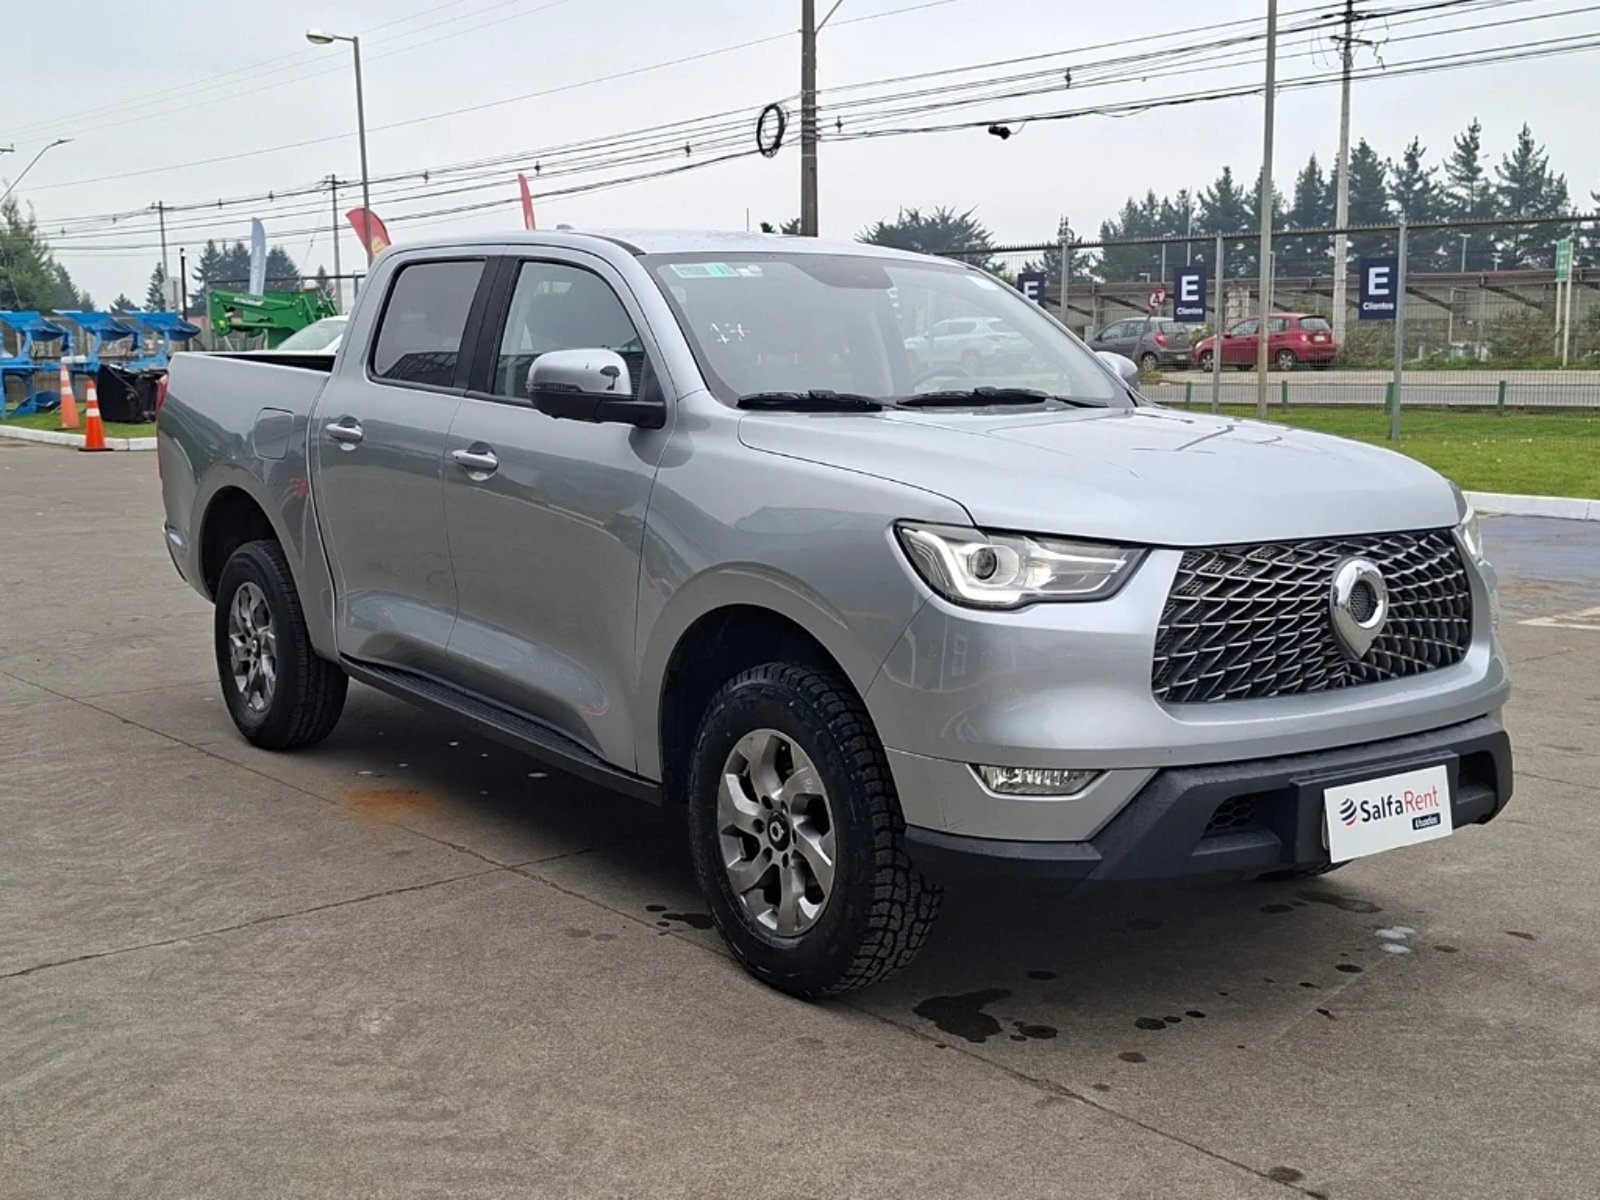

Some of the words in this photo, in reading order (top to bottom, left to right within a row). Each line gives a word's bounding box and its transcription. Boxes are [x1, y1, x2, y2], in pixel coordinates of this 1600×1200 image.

[1181, 274, 1200, 301] E
[1368, 266, 1390, 295] E
[1362, 301, 1394, 310] Clientes
[1360, 785, 1440, 823] SalfaRent
